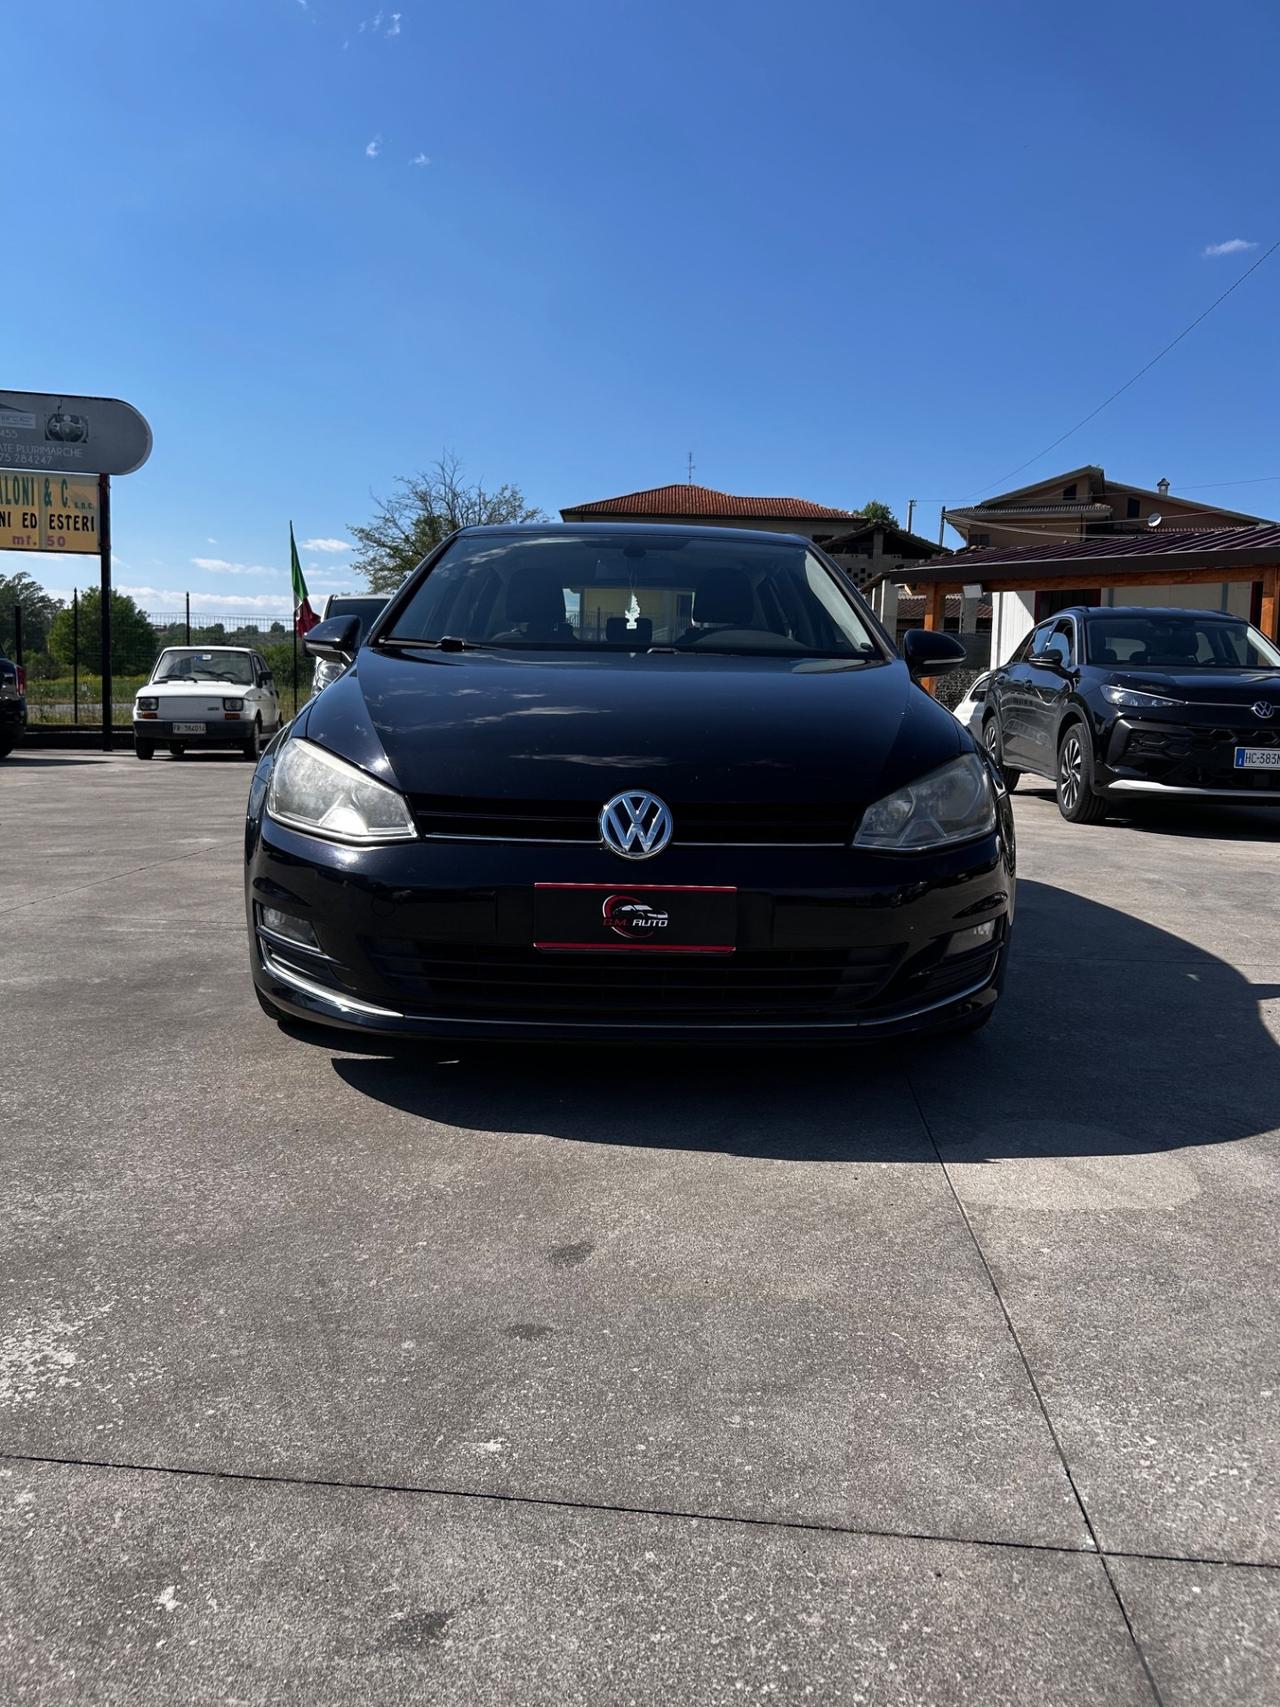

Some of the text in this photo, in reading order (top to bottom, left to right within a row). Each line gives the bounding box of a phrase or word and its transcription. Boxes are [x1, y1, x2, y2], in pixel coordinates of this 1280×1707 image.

[44, 478, 52, 507] &
[22, 512, 37, 529] ED
[49, 513, 95, 532] ESTERI
[47, 535, 66, 547] 50
[632, 919, 668, 927] AUTO
